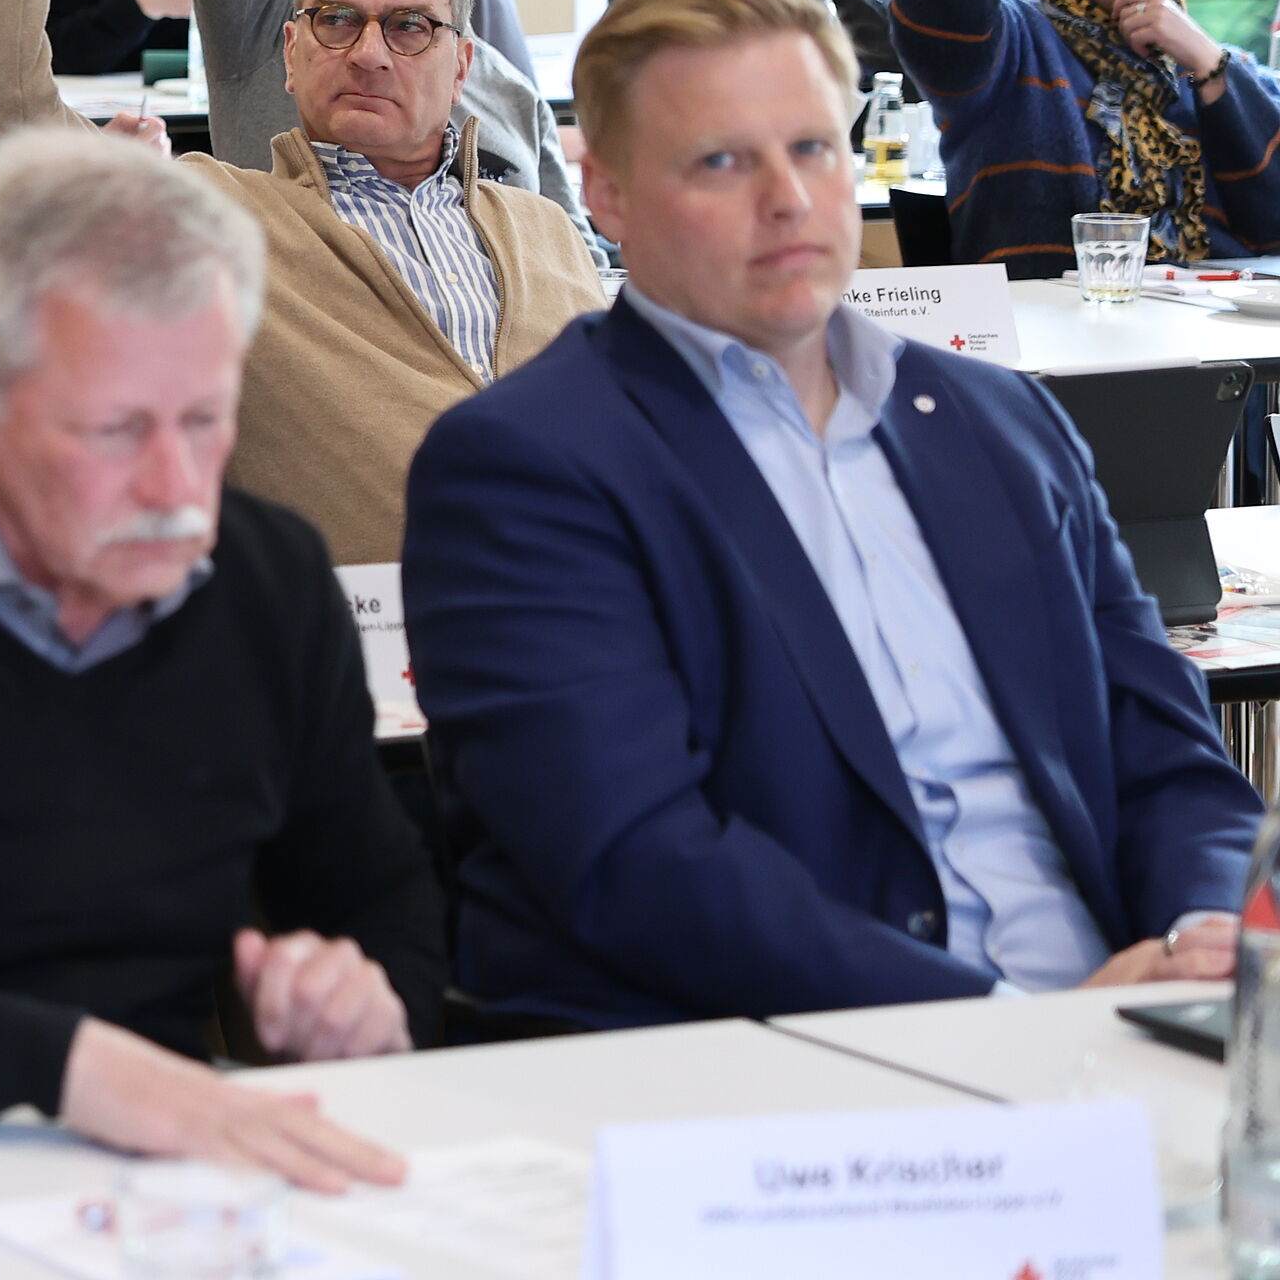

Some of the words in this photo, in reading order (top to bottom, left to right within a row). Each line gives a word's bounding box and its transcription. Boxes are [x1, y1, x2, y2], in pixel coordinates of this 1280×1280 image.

[842, 289, 872, 303] nke
[876, 286, 942, 303] Frieling
[347, 595, 381, 614] ke
